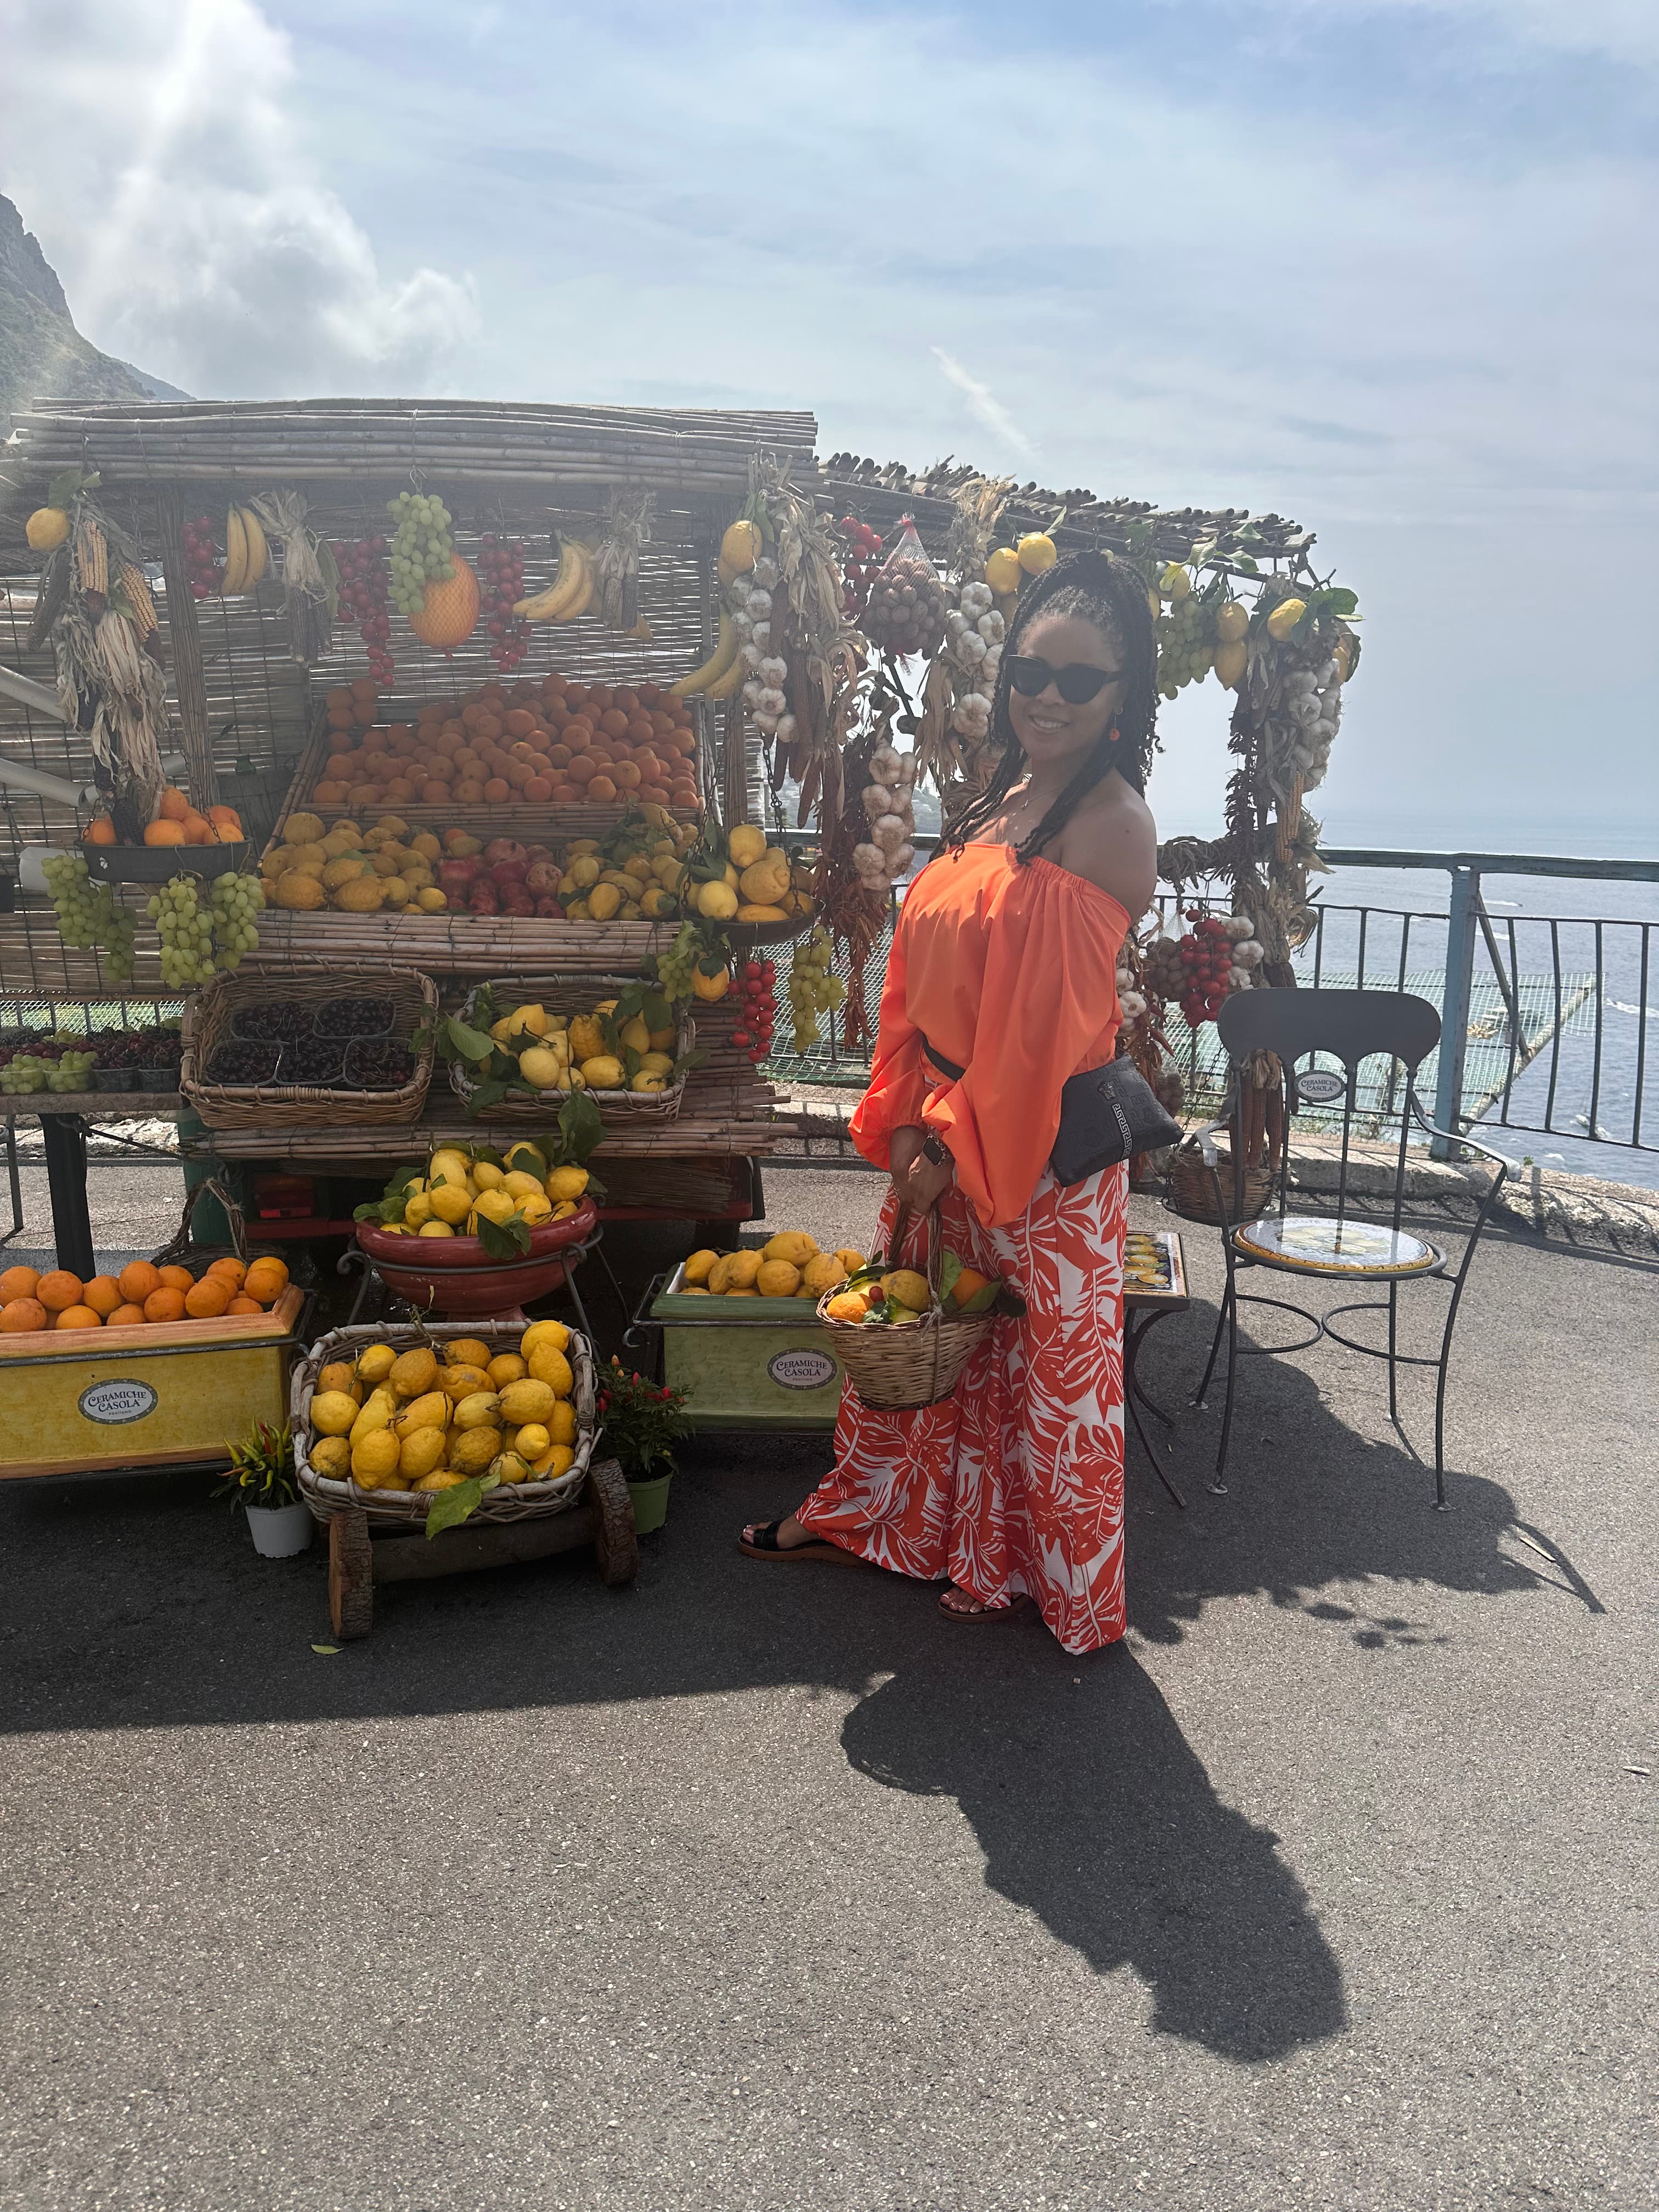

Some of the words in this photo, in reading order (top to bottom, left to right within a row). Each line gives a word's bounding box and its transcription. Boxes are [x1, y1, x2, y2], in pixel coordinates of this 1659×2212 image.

[1301, 1079, 1339, 1087] CERAMICHE
[776, 1360, 827, 1371] CERAMICHE
[785, 1368, 821, 1376] CASOLA
[88, 1391, 146, 1407] CERAMICHE
[98, 1399, 140, 1412] CASOLA
